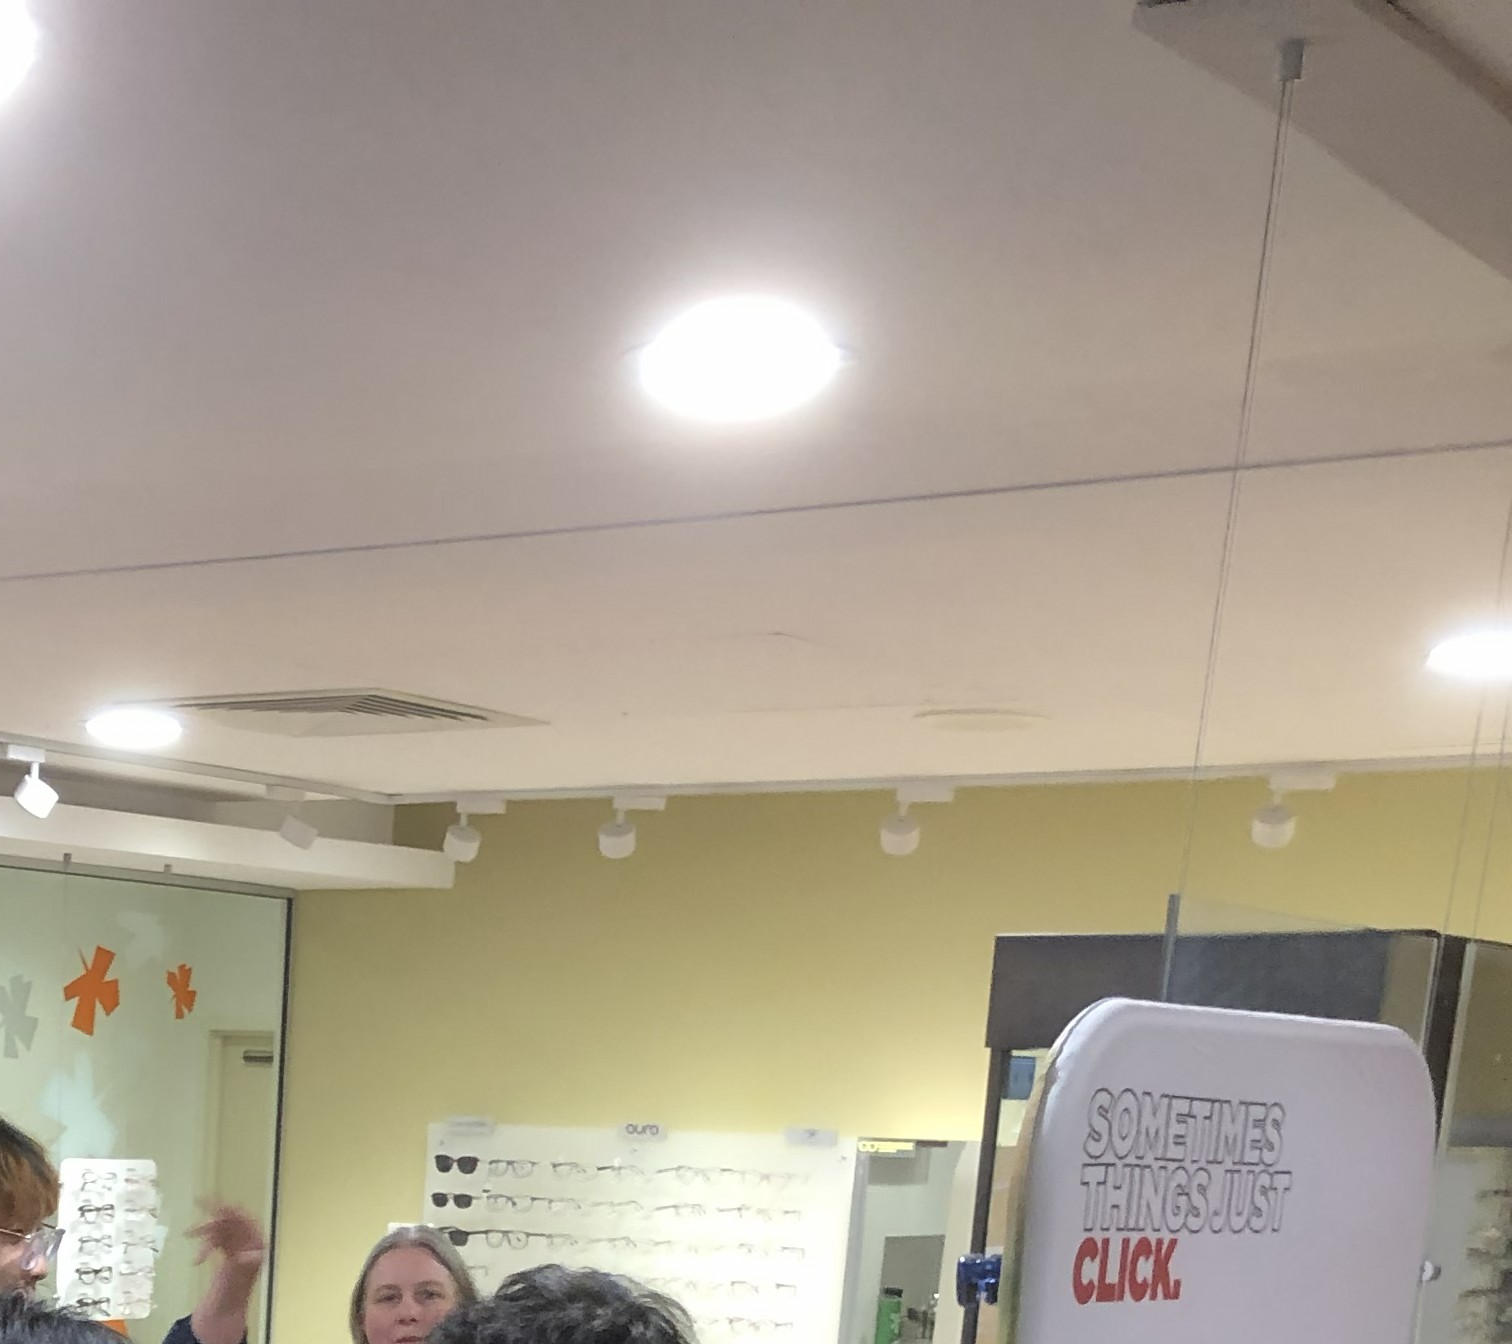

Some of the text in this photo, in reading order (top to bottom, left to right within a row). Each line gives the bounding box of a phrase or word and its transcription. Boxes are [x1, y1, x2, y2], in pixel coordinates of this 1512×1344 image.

[1083, 1088, 1286, 1167] SOMETIMES
[1080, 1163, 1292, 1234] THINGS JUST
[1072, 1236, 1182, 1305] CLICK.
